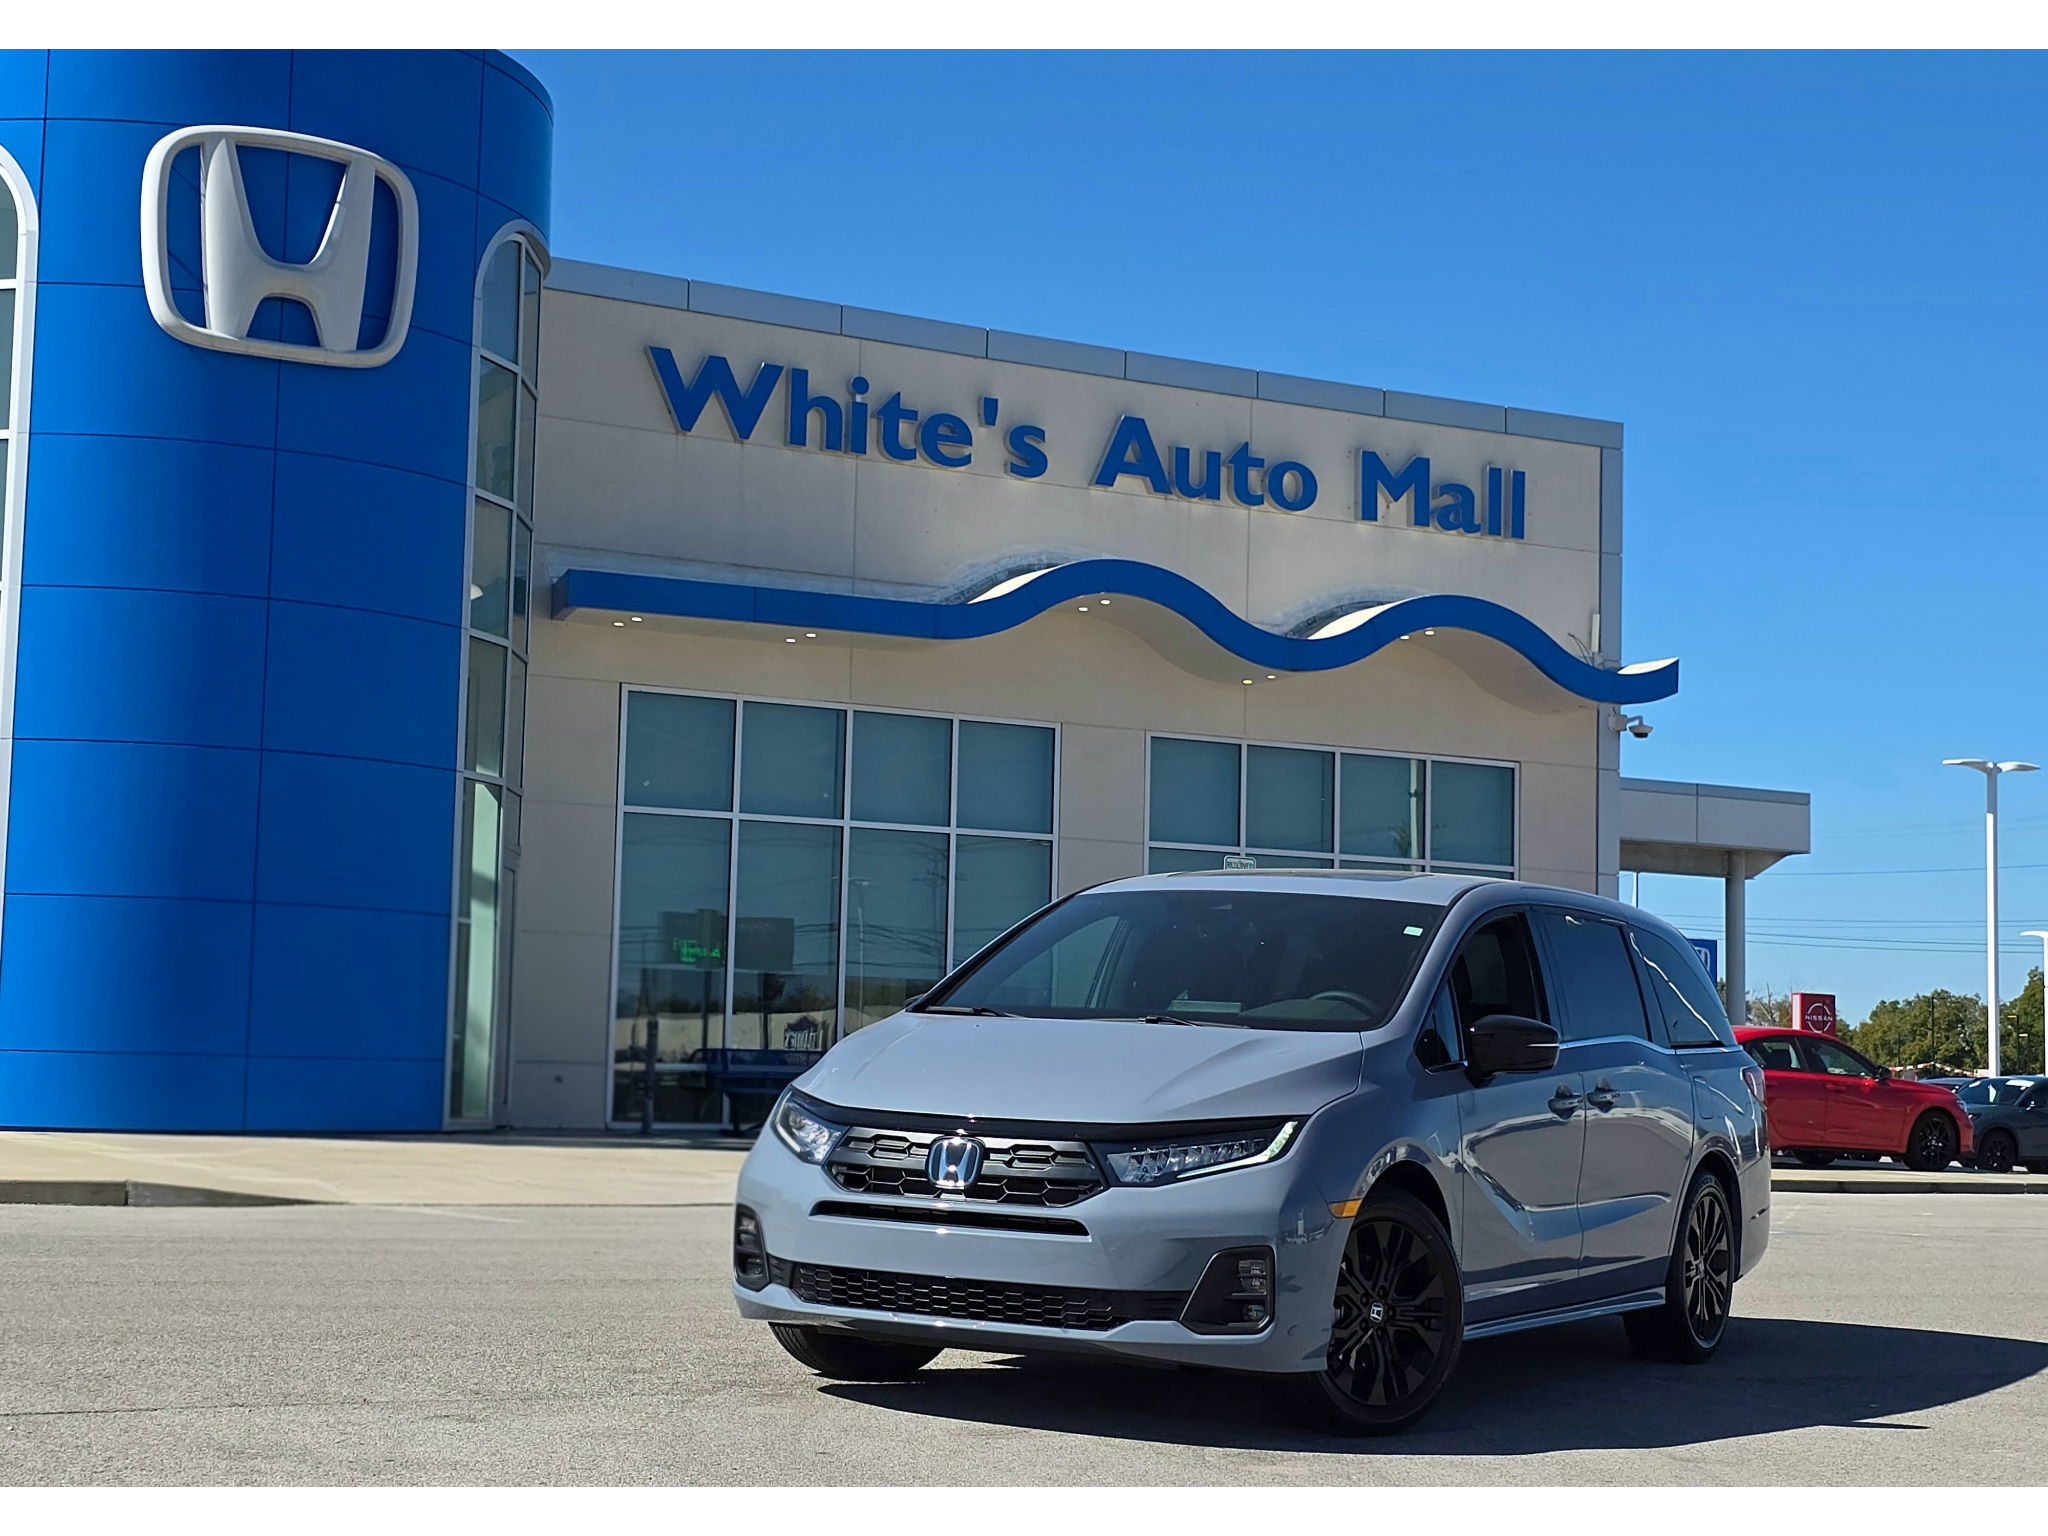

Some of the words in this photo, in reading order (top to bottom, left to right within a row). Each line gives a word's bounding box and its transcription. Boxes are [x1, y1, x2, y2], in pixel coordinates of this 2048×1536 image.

[645, 345, 1049, 480] White's
[1089, 414, 1319, 513] Auto
[1357, 448, 1526, 541] Mall
[1804, 1014, 1833, 1022] NISSAN
